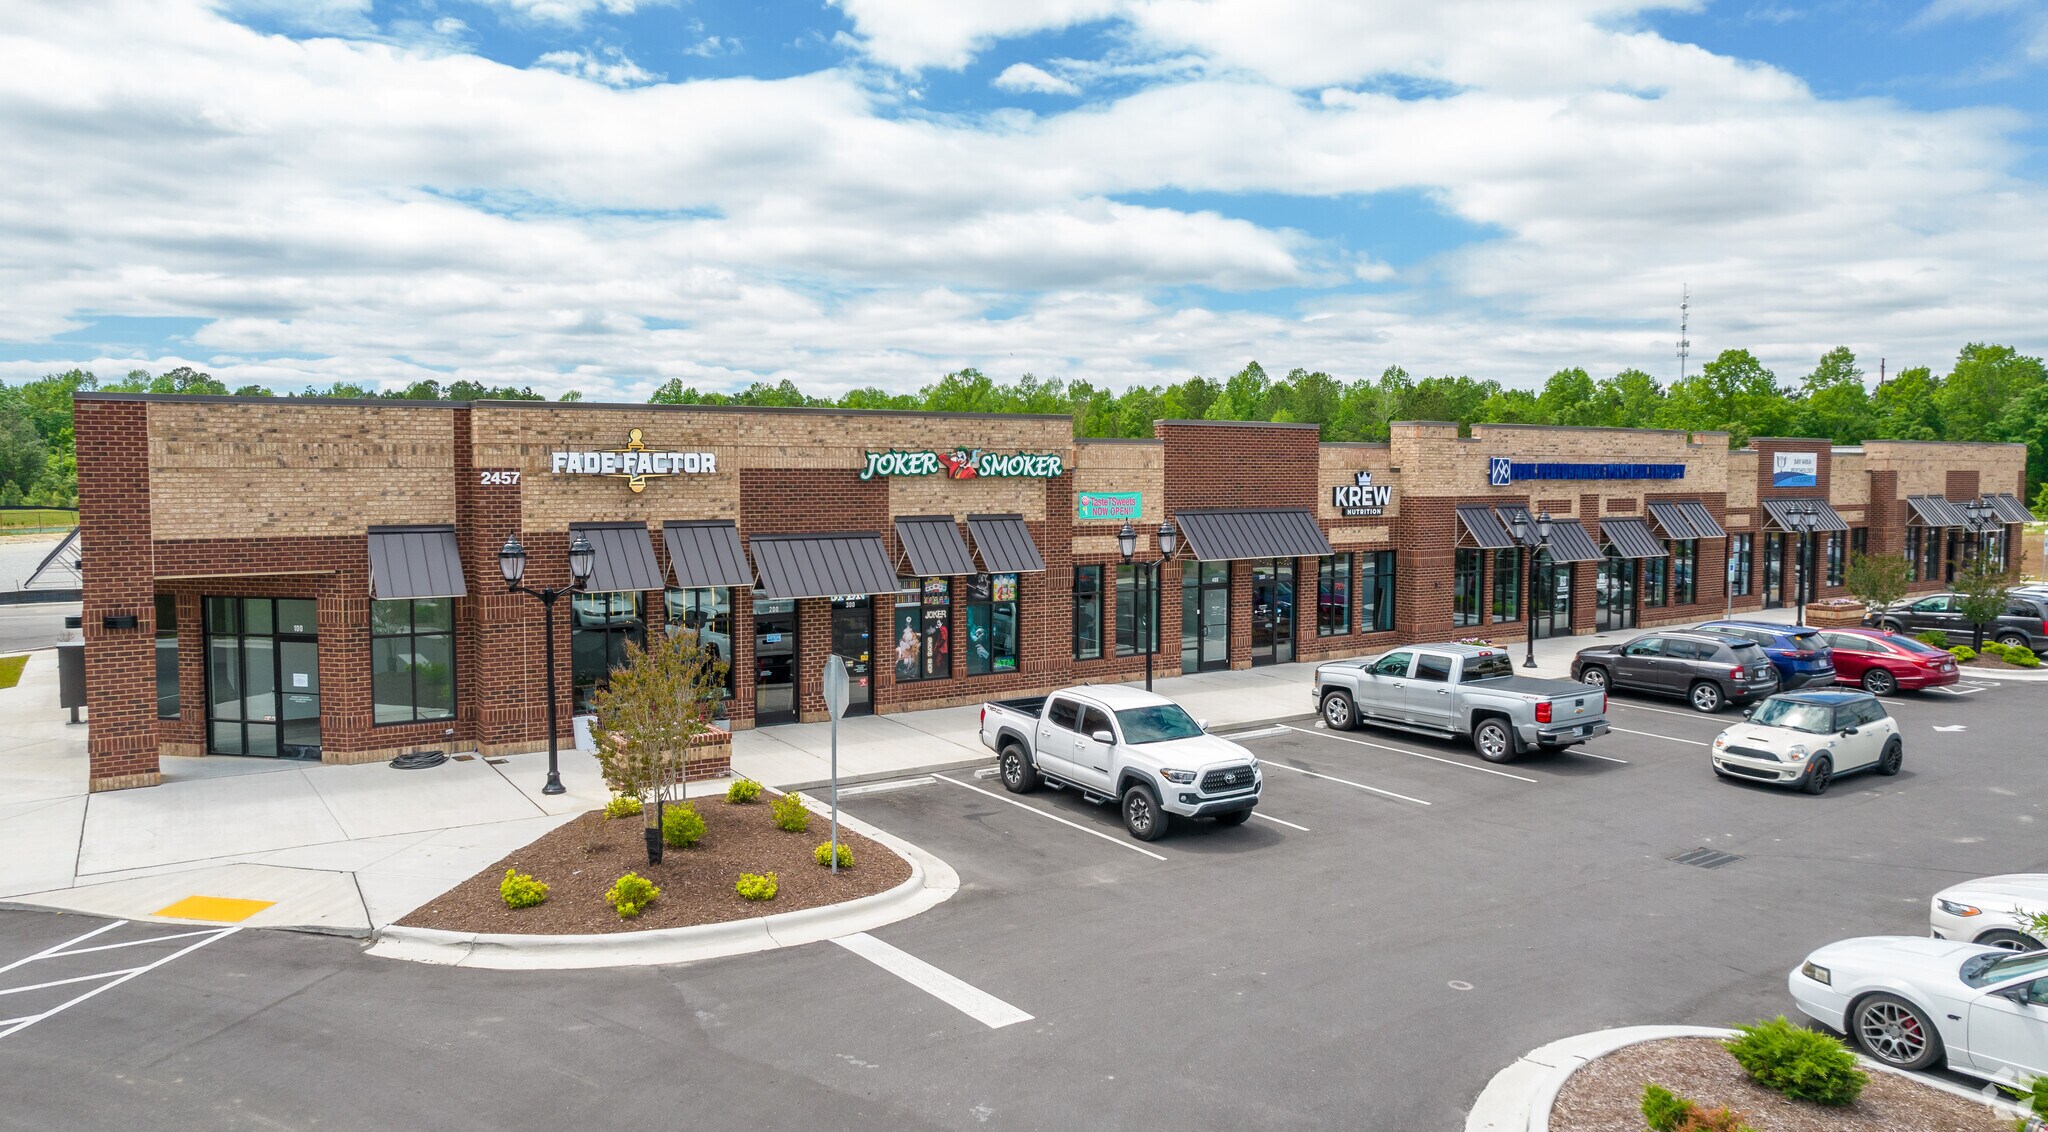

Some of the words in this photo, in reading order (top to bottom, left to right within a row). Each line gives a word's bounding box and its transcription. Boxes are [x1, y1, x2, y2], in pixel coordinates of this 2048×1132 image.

[551, 452, 616, 474] FADE
[622, 452, 716, 474] FACTOR
[860, 450, 938, 481] JOKER
[979, 452, 1063, 478] SMOKER
[480, 471, 520, 485] 2457
[1334, 485, 1392, 507] KREW
[1092, 507, 1108, 516] NOW
[924, 609, 947, 620] JOKER
[293, 624, 304, 632] 100
[996, 658, 1015, 667] ATM
